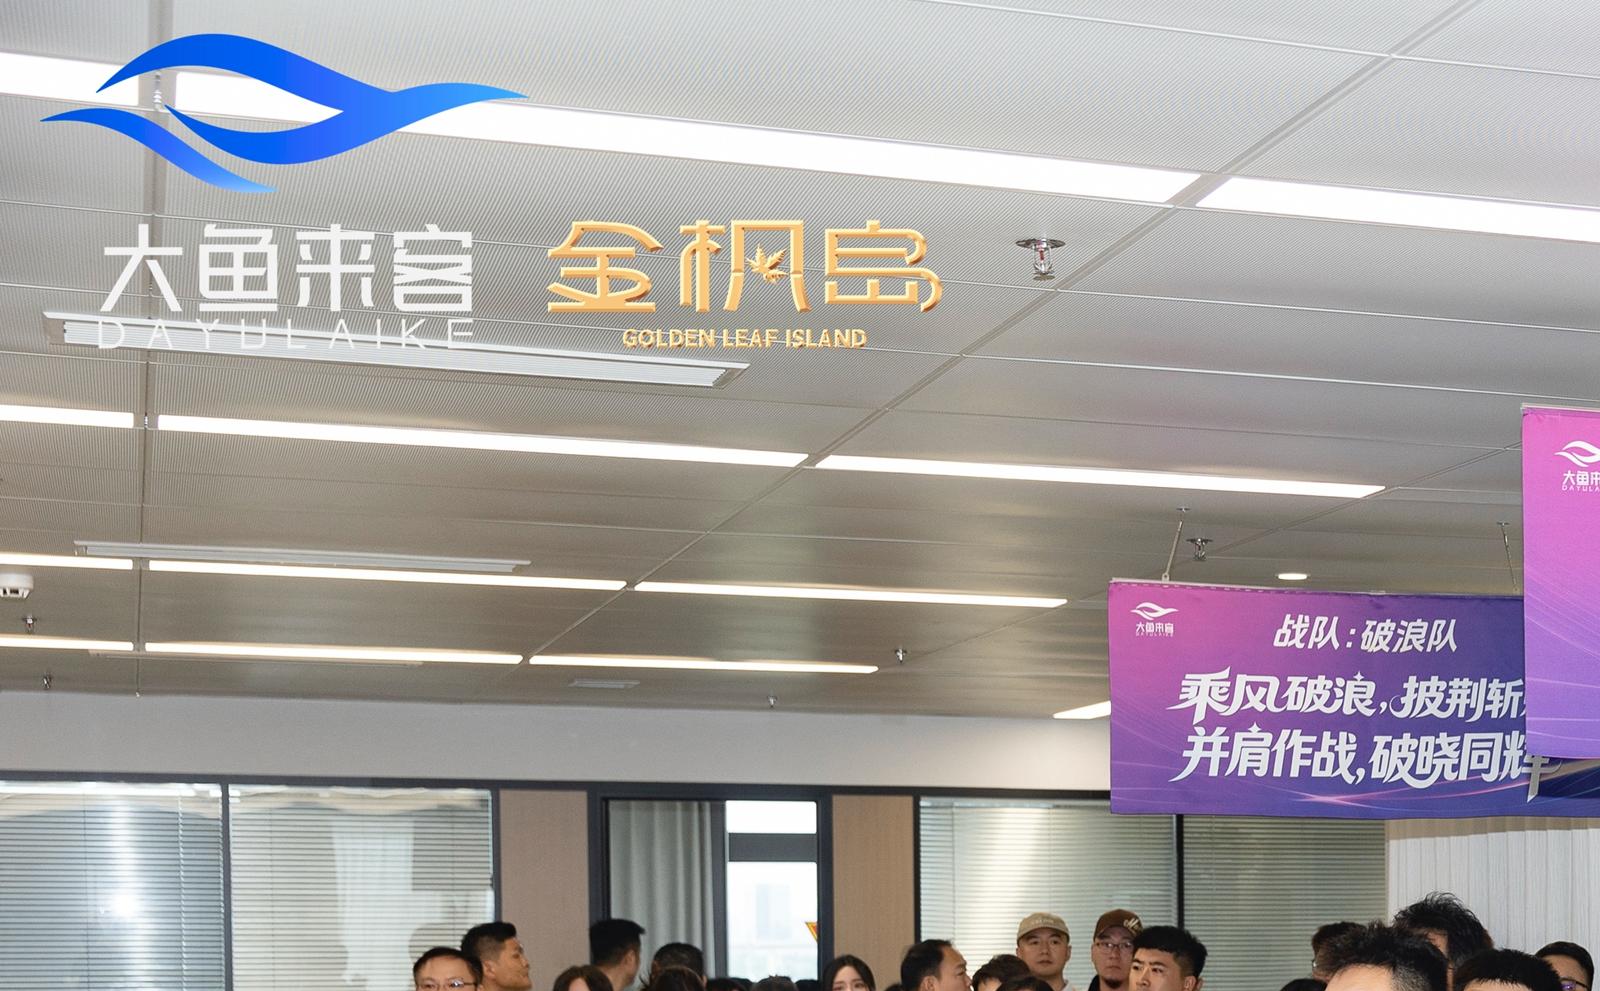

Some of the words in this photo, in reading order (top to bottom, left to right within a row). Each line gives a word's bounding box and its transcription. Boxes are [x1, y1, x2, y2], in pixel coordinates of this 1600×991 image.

[1273, 613, 1457, 653] 战队：破浪队
[1165, 666, 1527, 726] 乘风破浪，披荆斩
